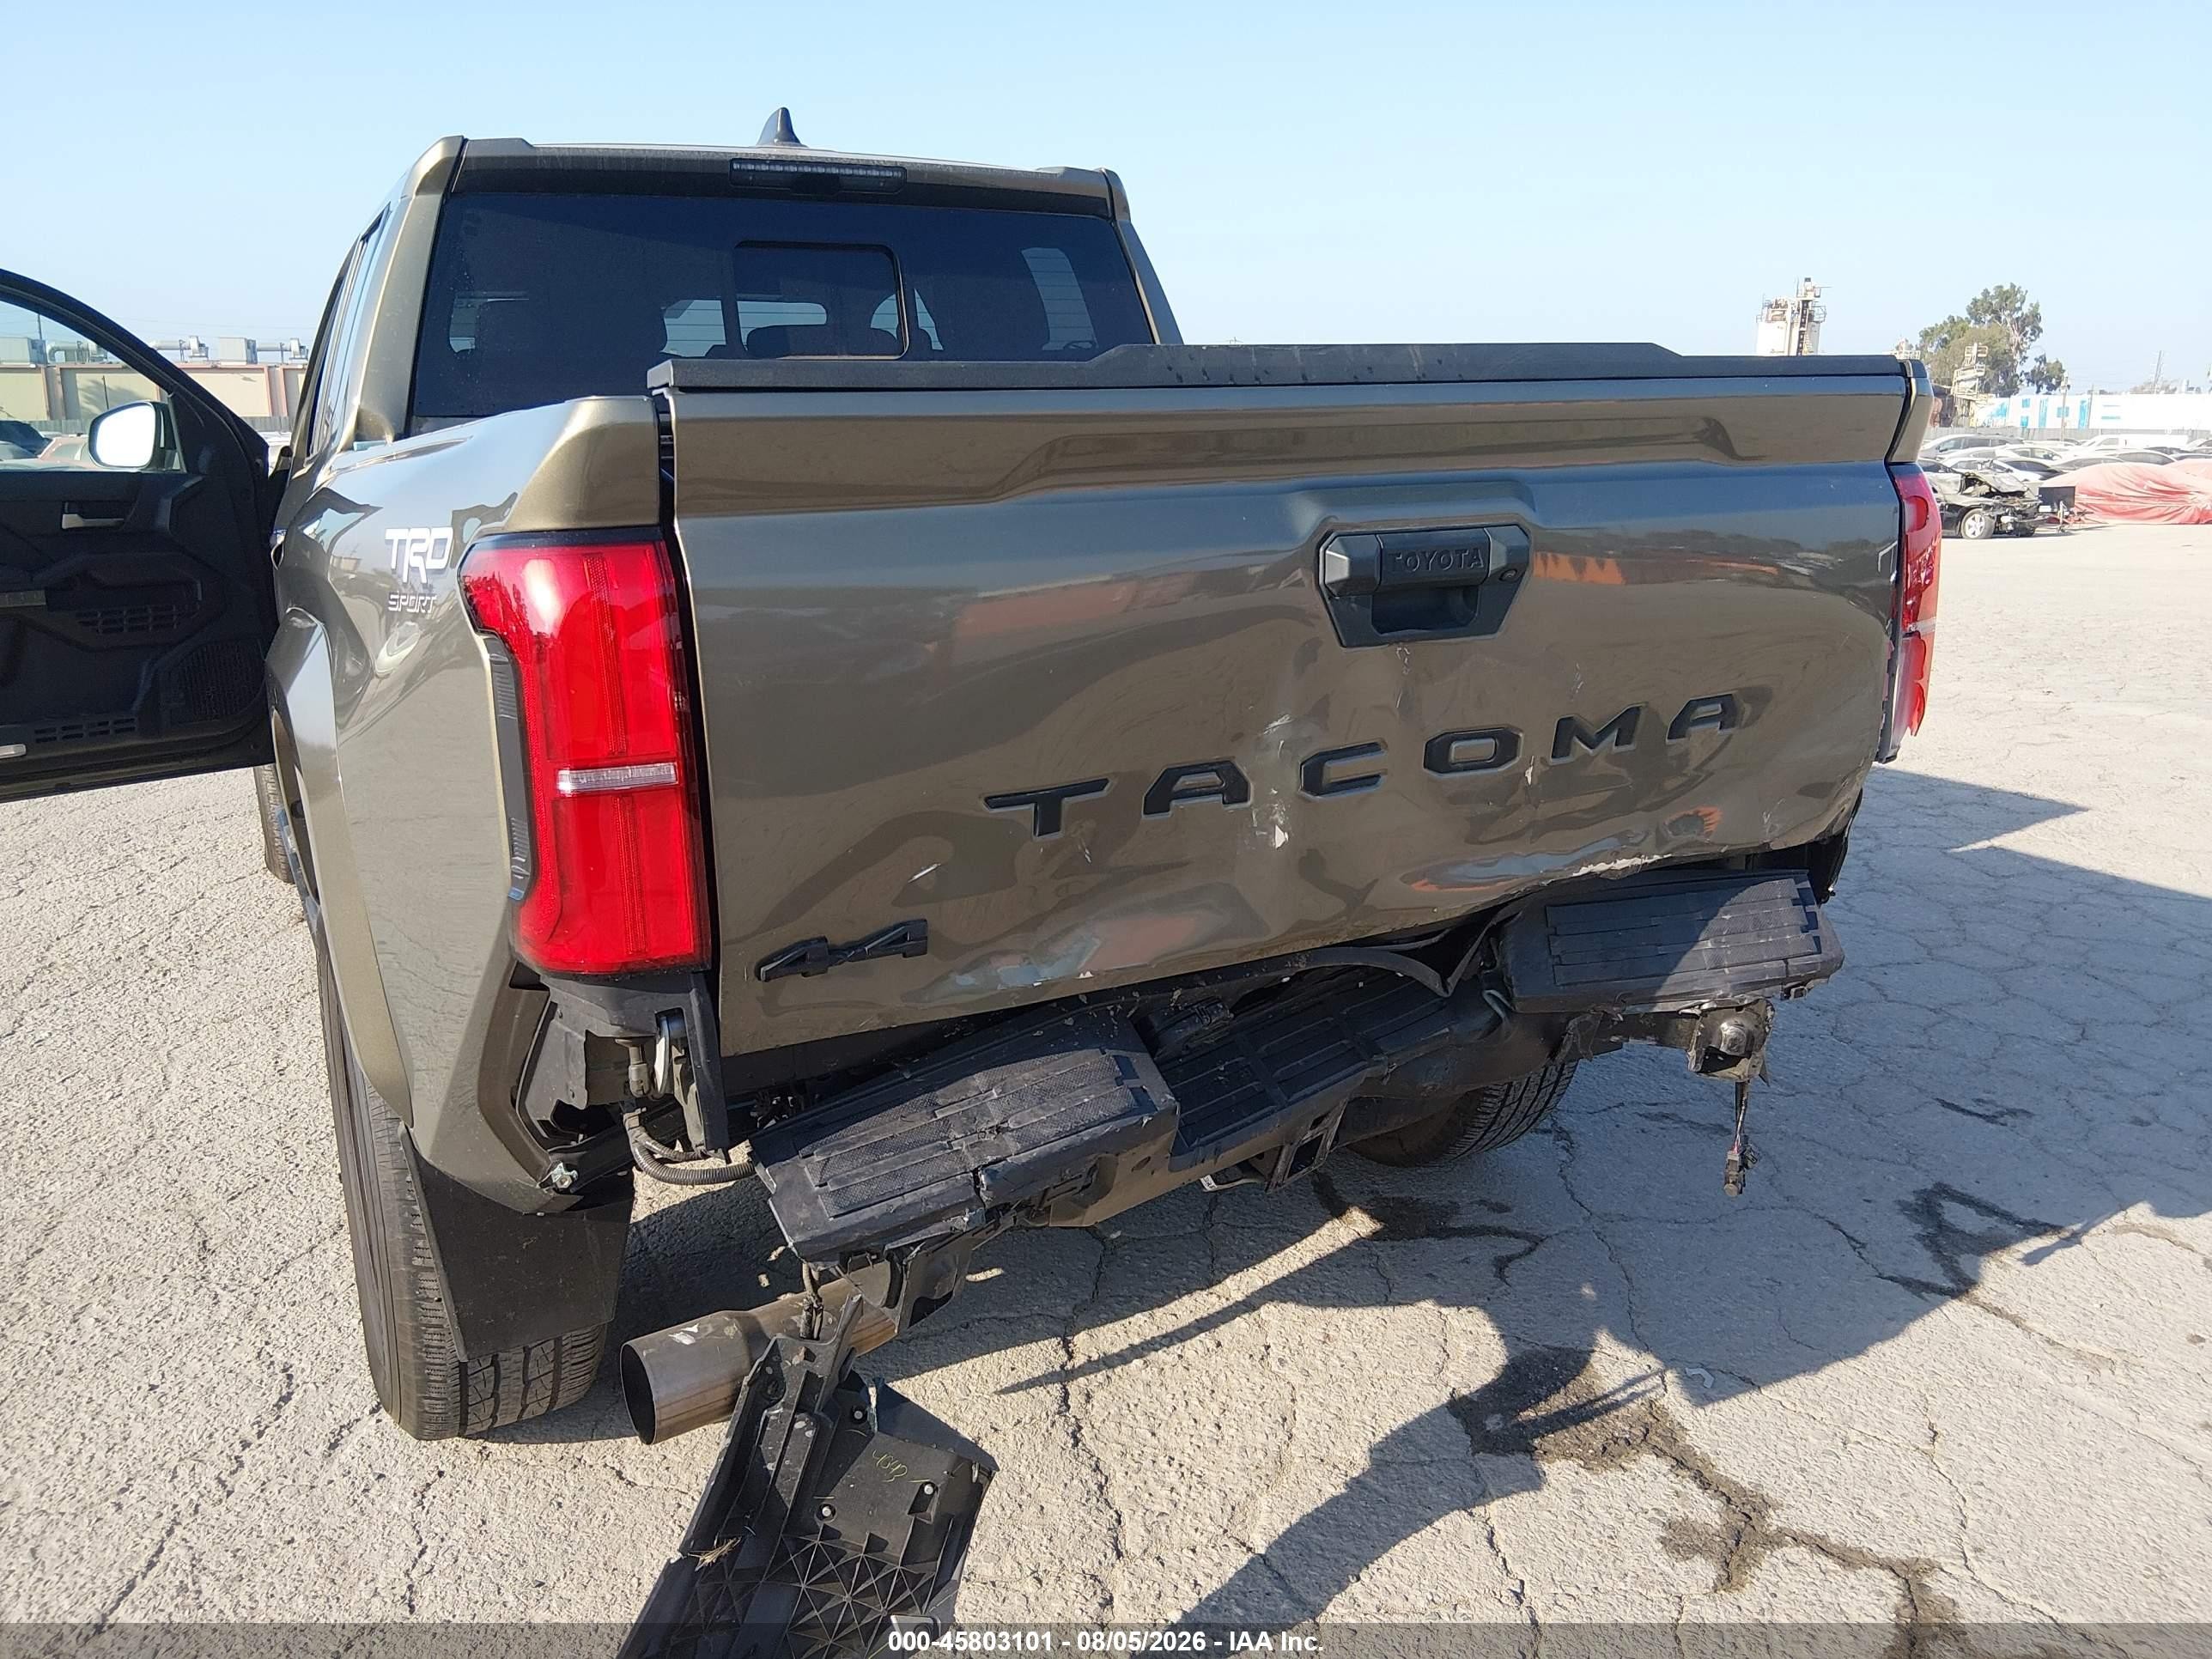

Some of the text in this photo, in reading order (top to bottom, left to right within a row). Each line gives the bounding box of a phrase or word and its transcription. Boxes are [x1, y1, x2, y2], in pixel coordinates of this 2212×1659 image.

[385, 527, 453, 584] TRD
[1389, 547, 1486, 573] TOYOTA
[387, 592, 437, 613] SPORT
[983, 692, 1740, 839] TACOMA
